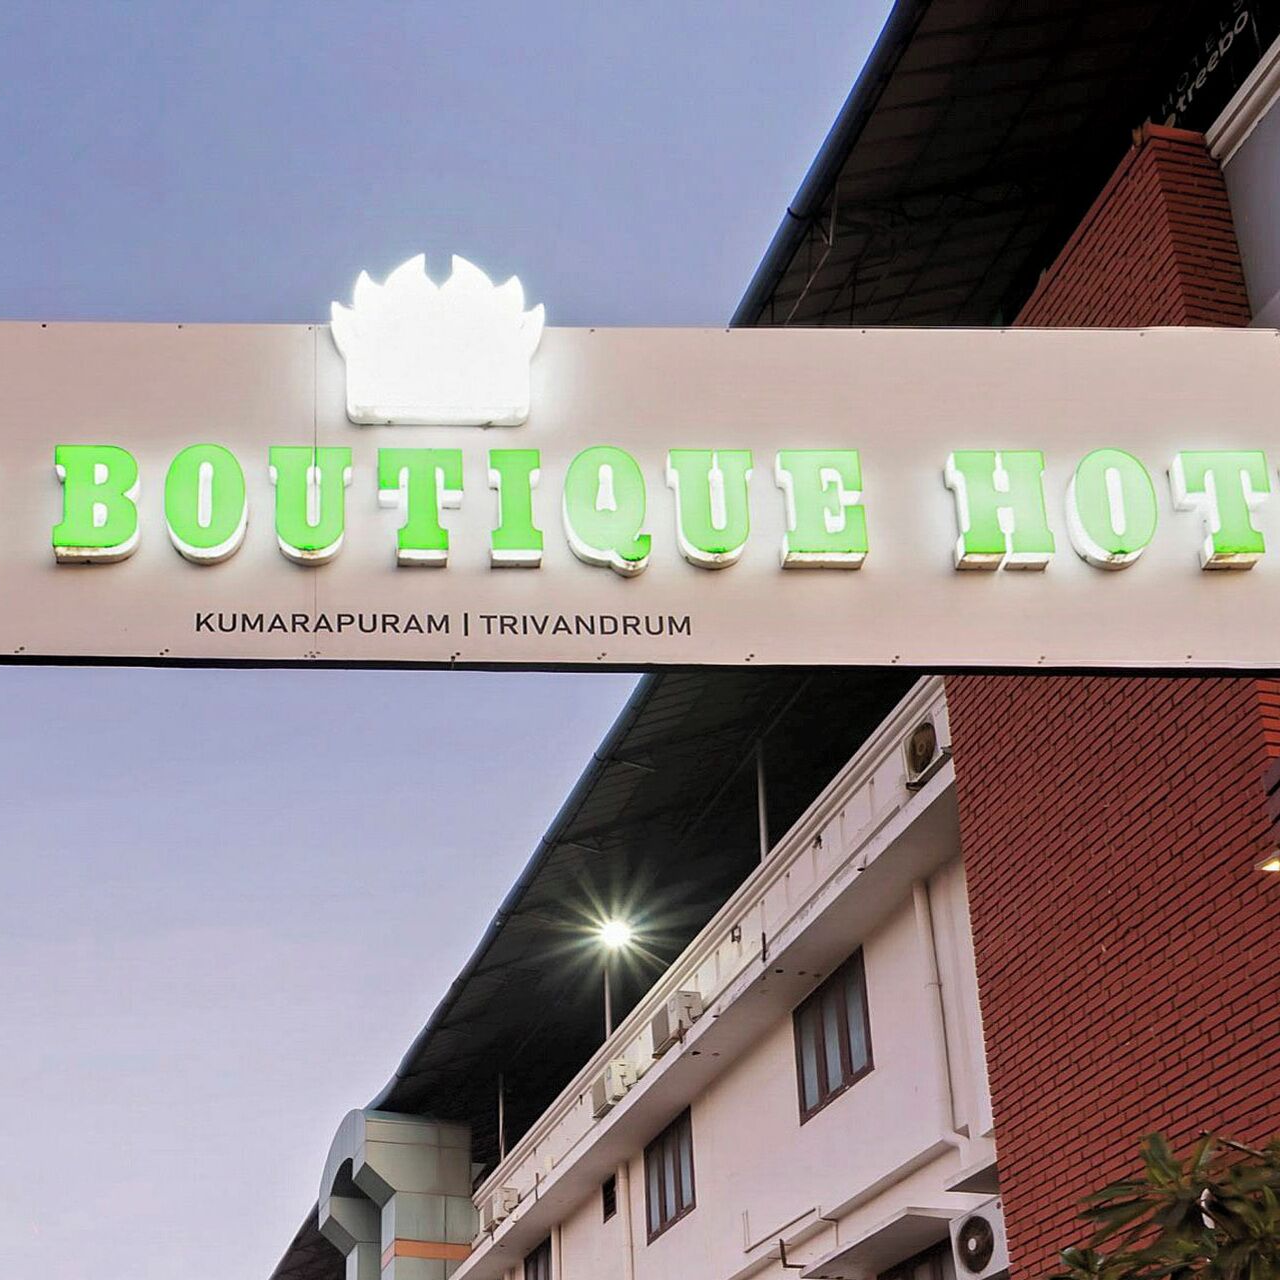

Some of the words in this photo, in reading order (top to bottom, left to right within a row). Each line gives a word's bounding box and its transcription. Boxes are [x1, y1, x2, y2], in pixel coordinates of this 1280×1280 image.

[1175, 10, 1249, 113] treebo
[53, 443, 868, 577] BOUTIQUE
[195, 612, 451, 634] KUMARAPURAM
[480, 614, 692, 636] TRIVANDRUM
